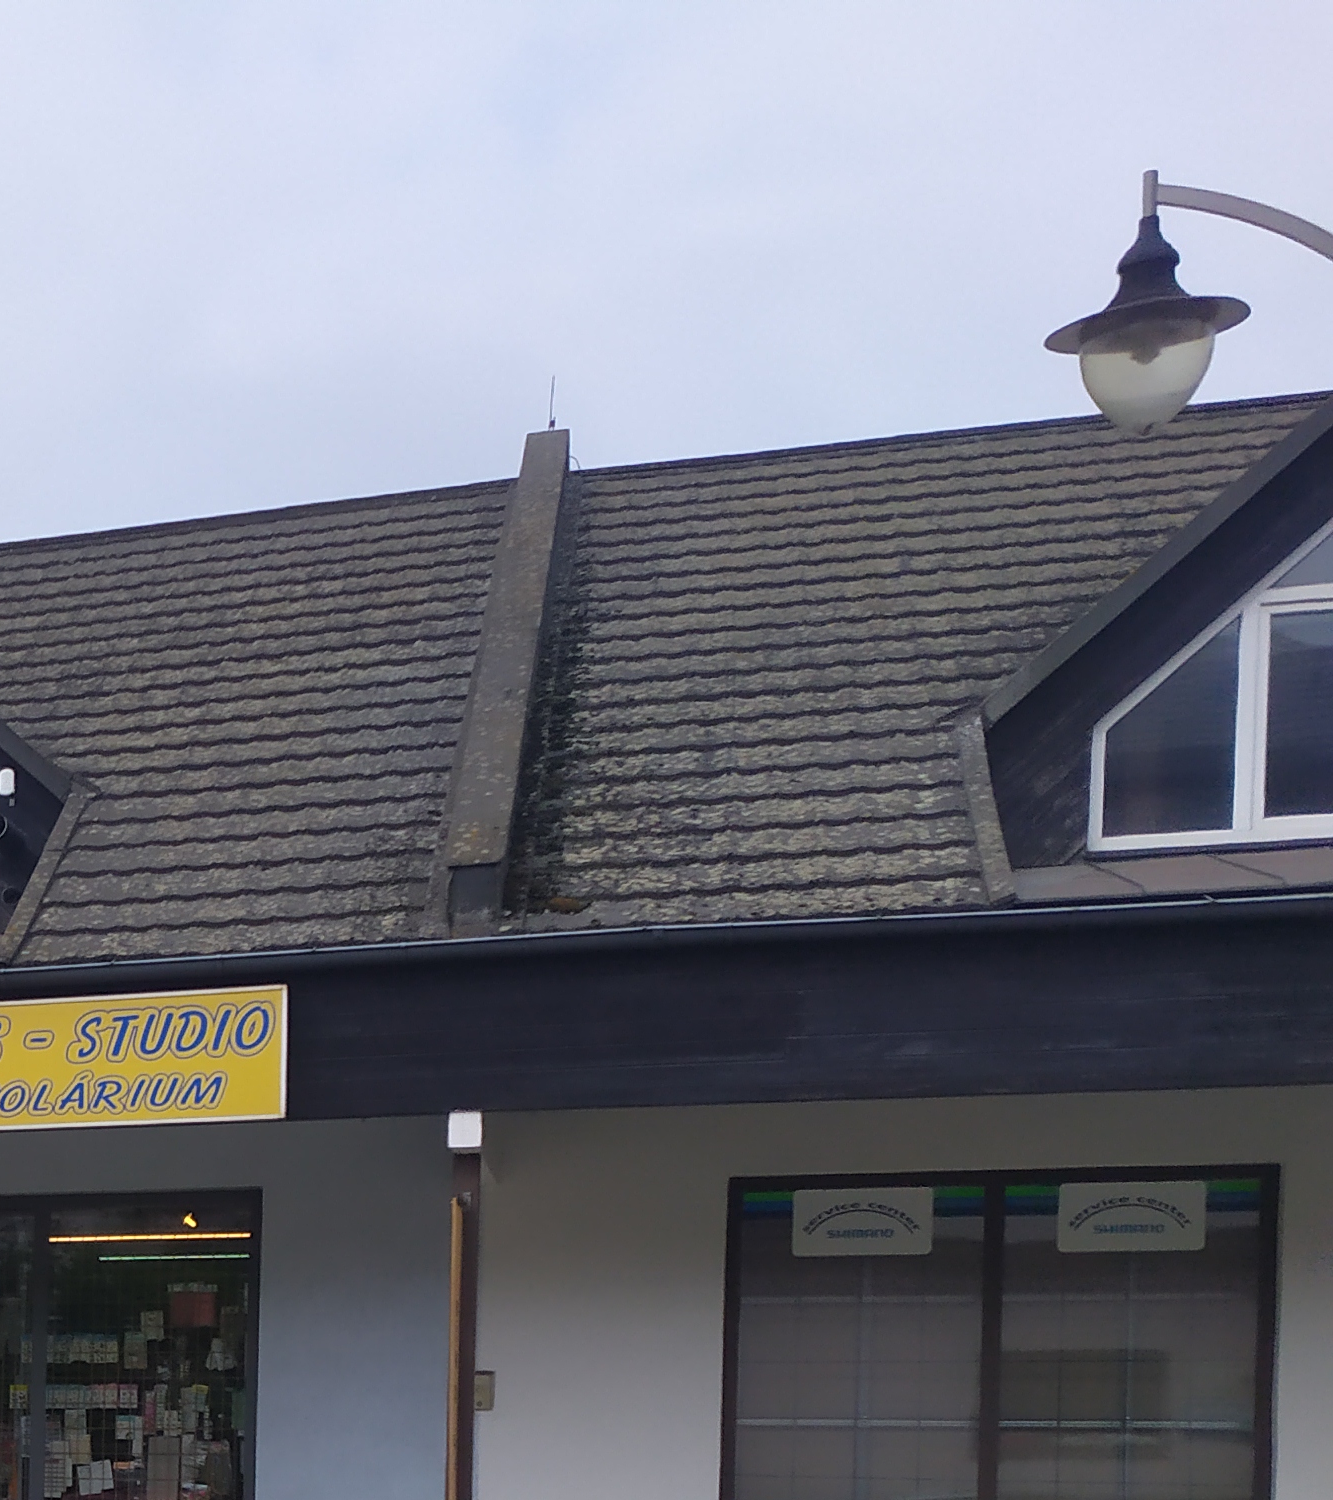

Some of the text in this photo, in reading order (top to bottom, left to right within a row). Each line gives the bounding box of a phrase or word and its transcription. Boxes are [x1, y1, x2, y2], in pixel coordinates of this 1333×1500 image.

[68, 1003, 274, 1062] STUDIO
[802, 1202, 921, 1233] service center
[1069, 1196, 1192, 1228] service center
[826, 1228, 895, 1239] SHIMANO
